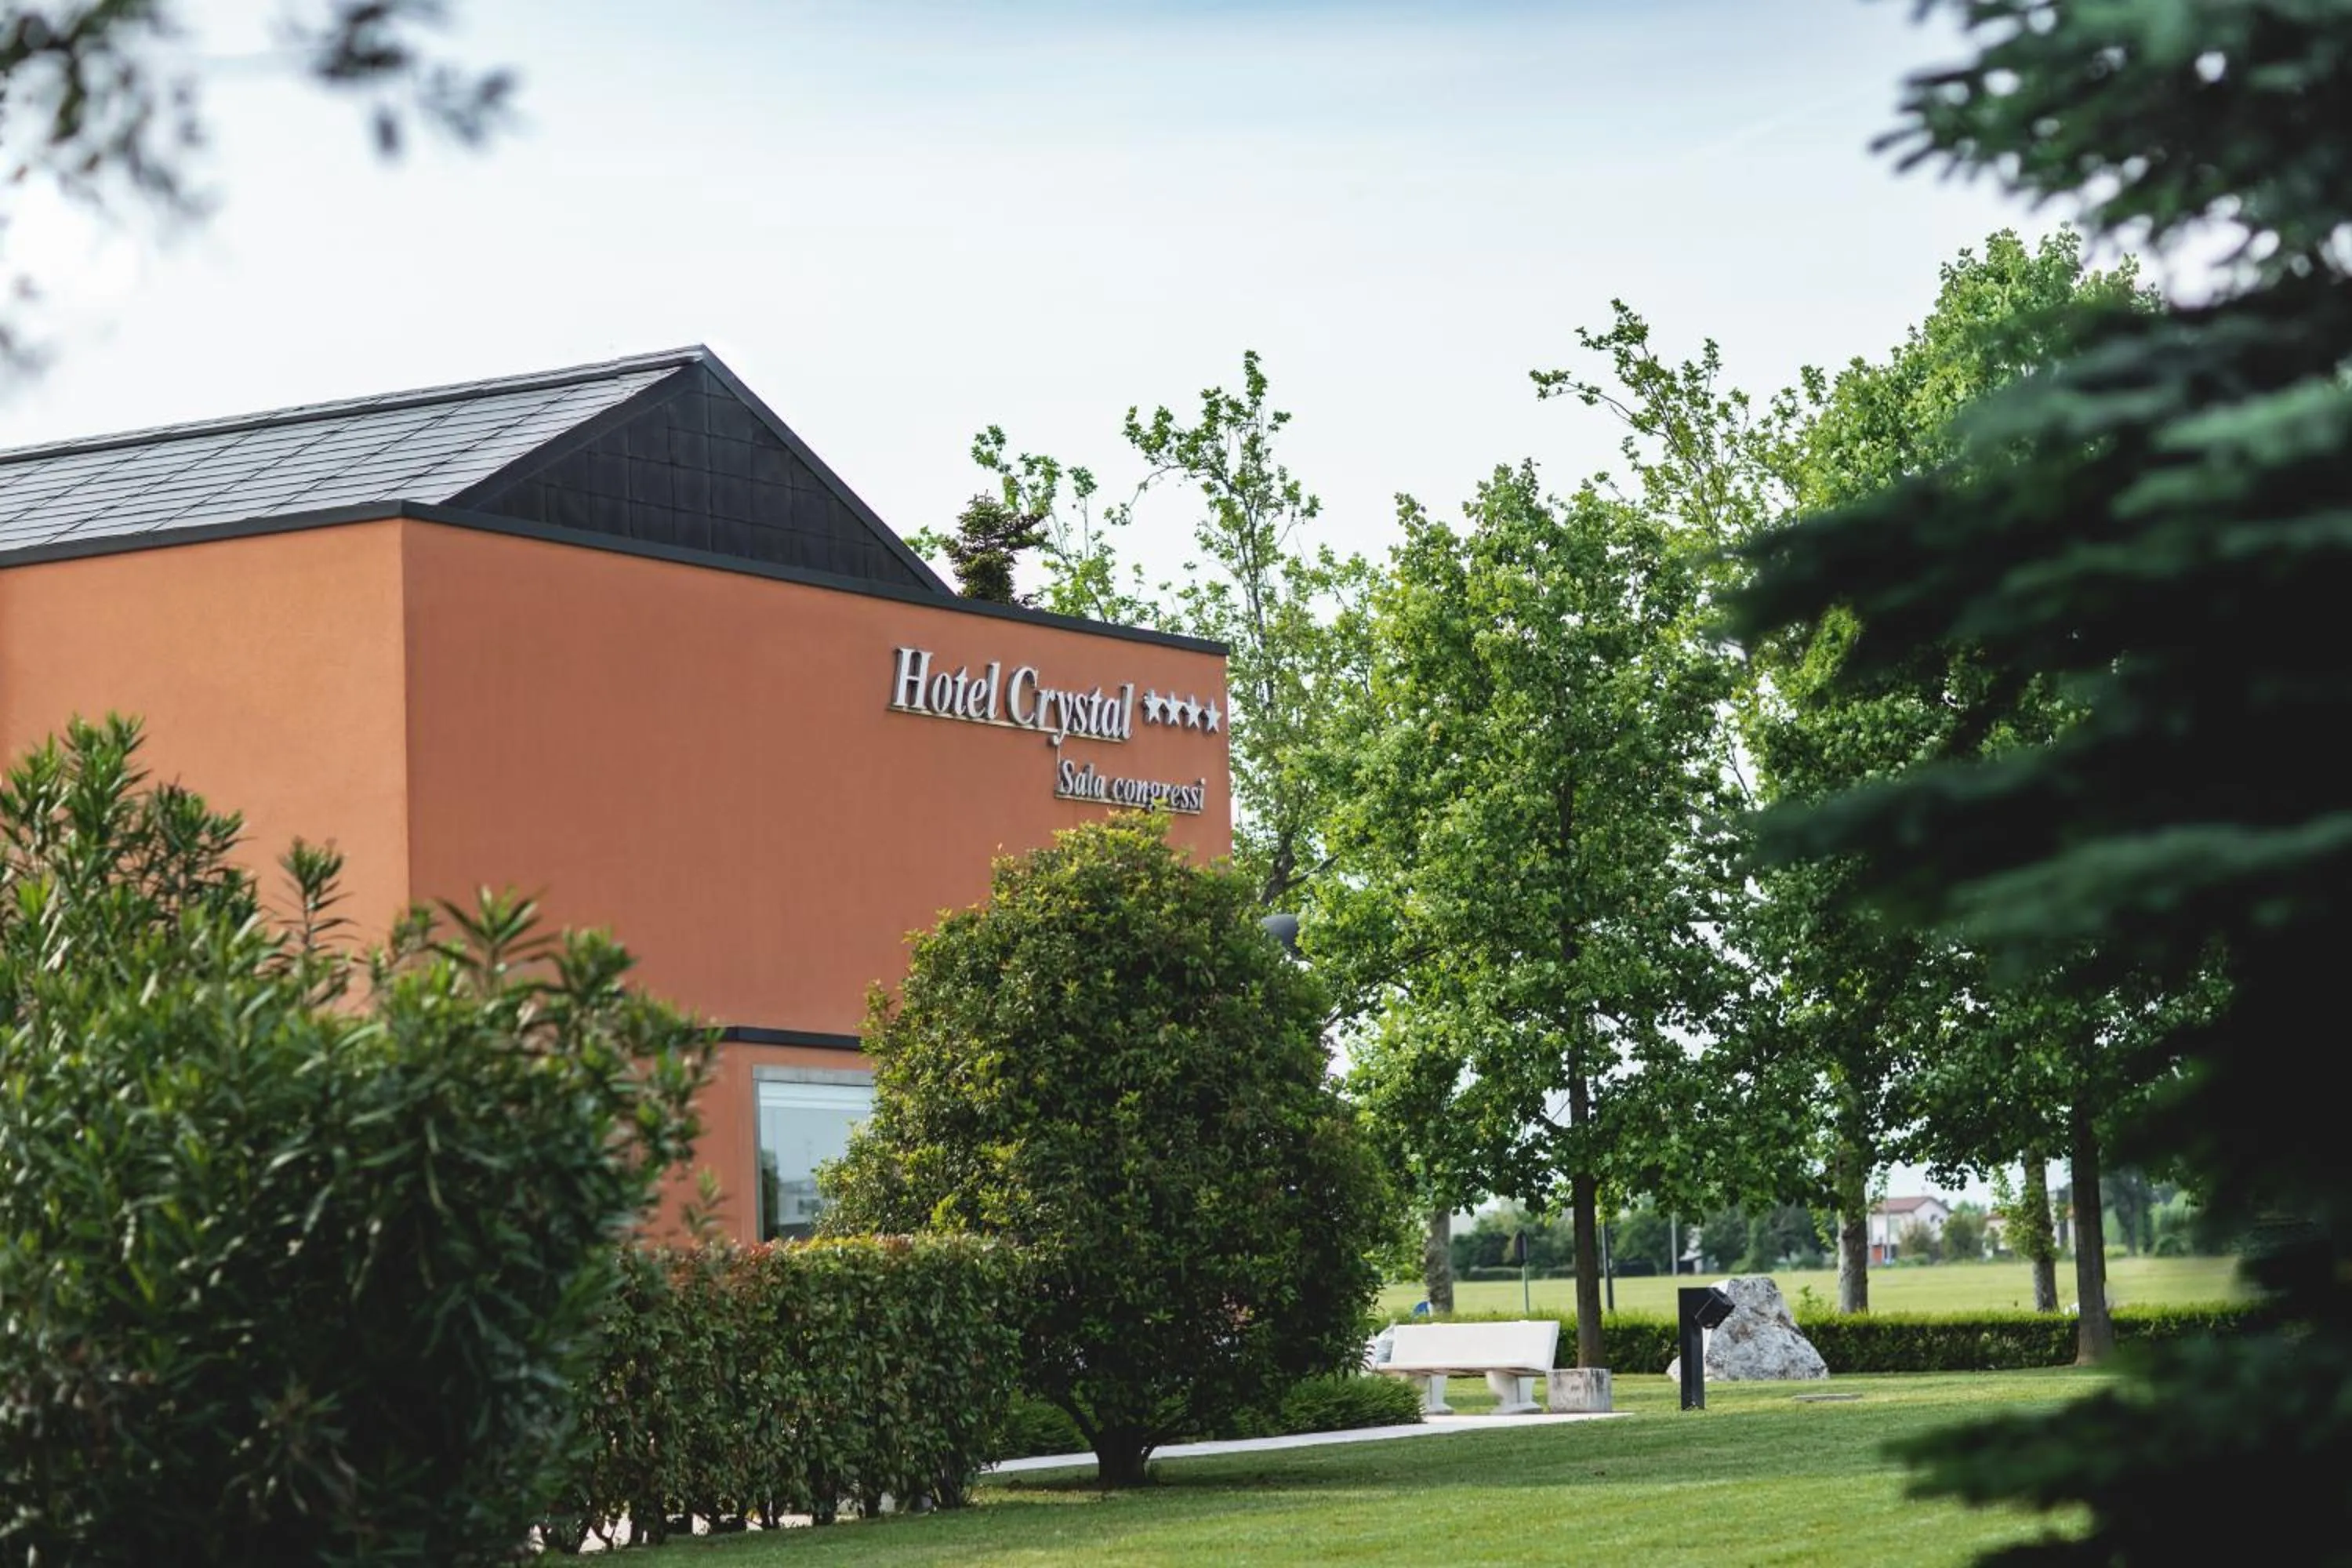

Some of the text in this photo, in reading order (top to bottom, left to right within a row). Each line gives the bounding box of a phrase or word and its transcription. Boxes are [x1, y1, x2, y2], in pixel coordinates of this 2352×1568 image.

[892, 647, 1134, 745] Hotel Crystal
[1059, 759, 1206, 812] Sala congressi
